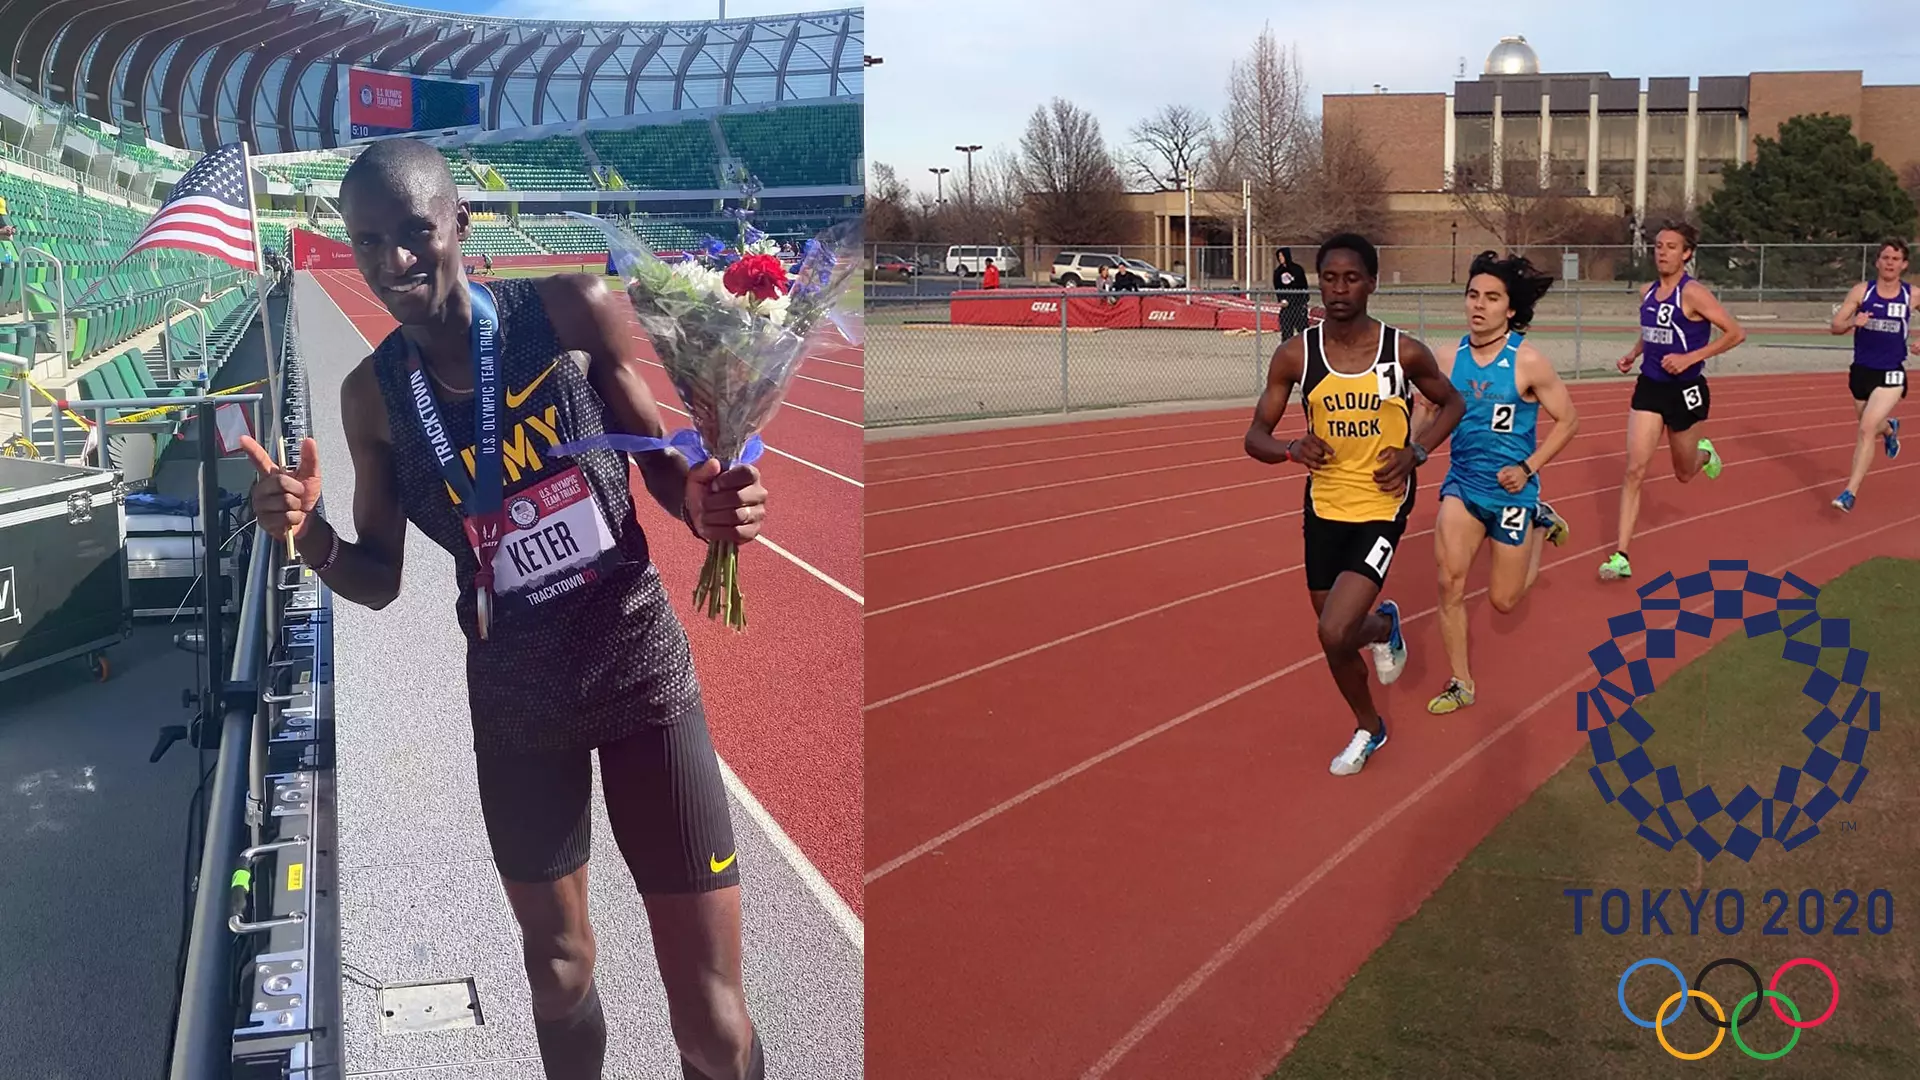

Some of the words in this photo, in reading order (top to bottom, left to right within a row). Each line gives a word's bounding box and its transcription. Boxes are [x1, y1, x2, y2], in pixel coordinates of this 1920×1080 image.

[352, 125, 368, 137] 5:10
[1031, 301, 1058, 312] GILL
[1148, 310, 1176, 321] GILL
[1658, 305, 1671, 324] 3
[1889, 304, 1903, 316] 11
[479, 319, 493, 352] TRIALS
[480, 357, 495, 383] TEAM
[1383, 364, 1397, 395] 1
[1887, 371, 1900, 384] 11
[481, 385, 496, 431] OLYMPIC
[1322, 392, 1383, 413] CLOUD
[1686, 389, 1700, 407] 3
[409, 369, 454, 467] TRACKTOWN
[1327, 418, 1382, 438] TRACK
[1493, 406, 1512, 431] 2
[482, 433, 496, 454] U.S.
[538, 486, 552, 499] U.S.
[551, 474, 578, 493] OLYMPIC
[542, 492, 561, 508] TEAM
[559, 483, 582, 500] TRIALS
[1503, 506, 1523, 528] 2
[505, 520, 581, 578] KETER
[1376, 545, 1391, 571] 1
